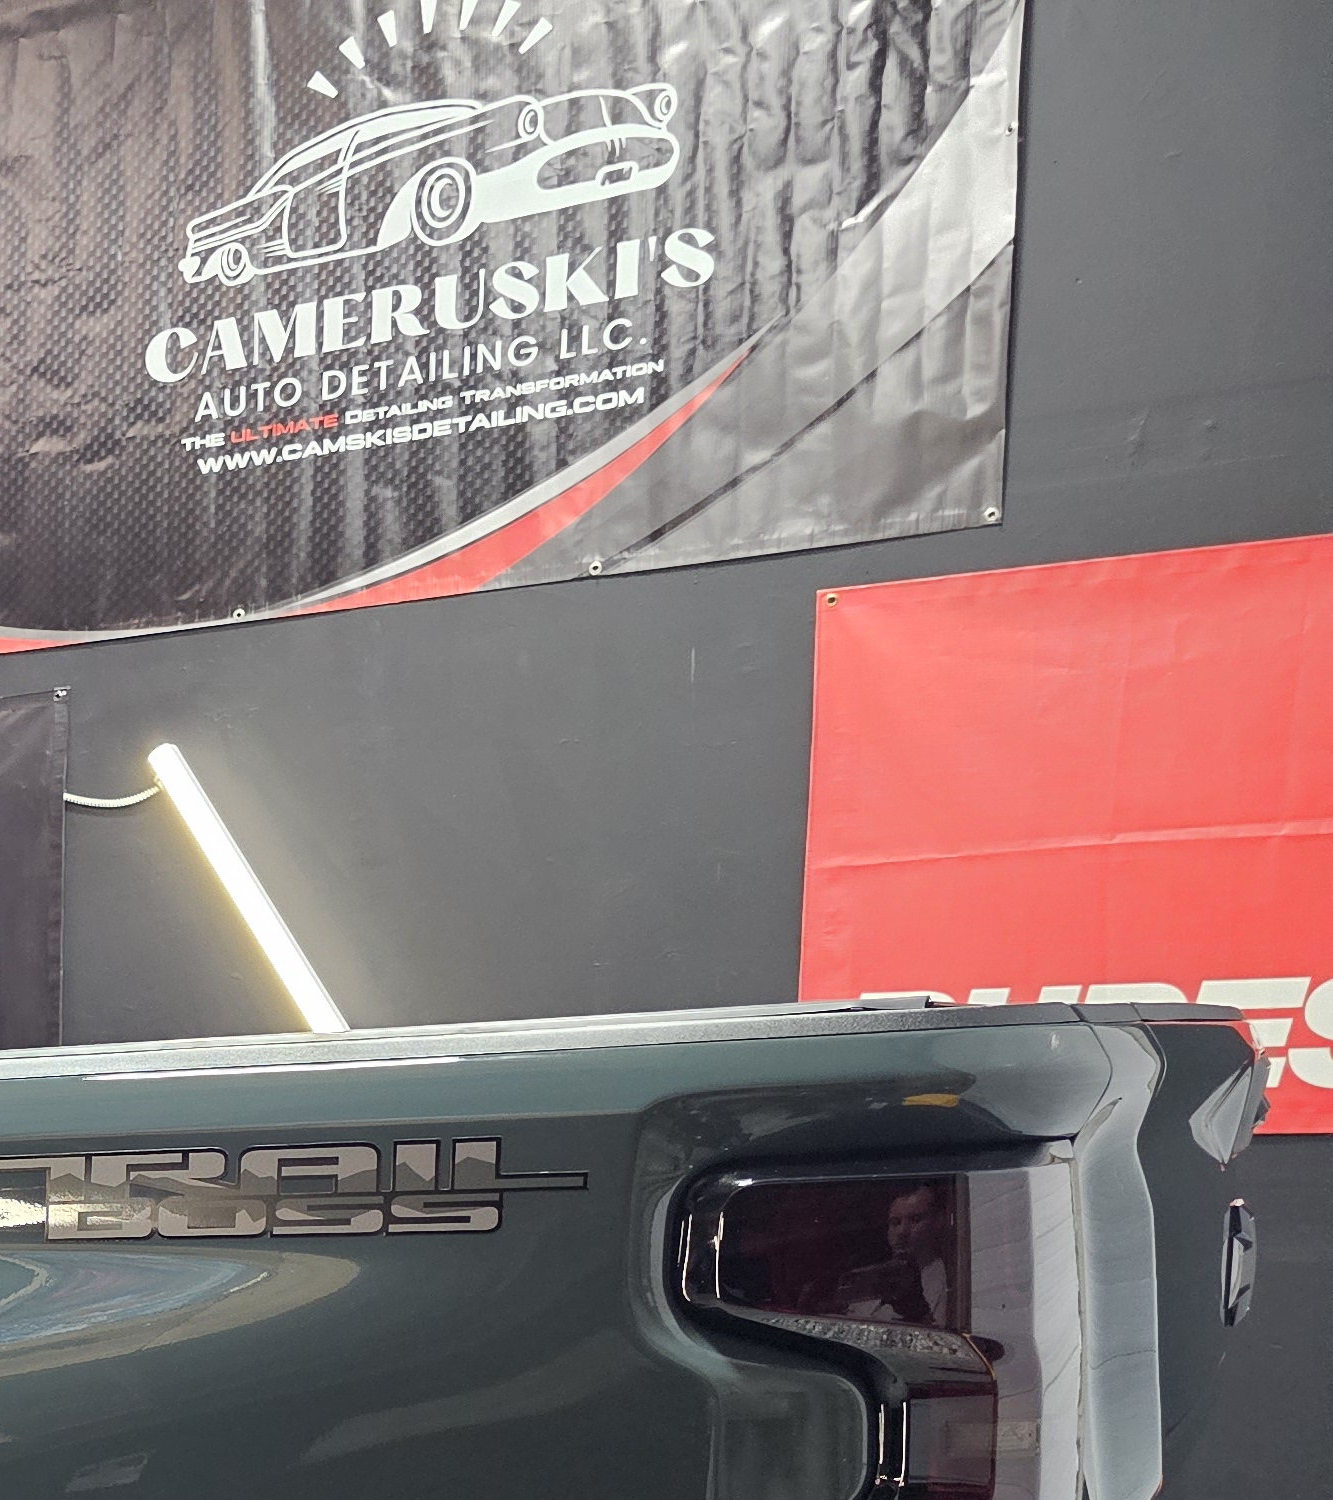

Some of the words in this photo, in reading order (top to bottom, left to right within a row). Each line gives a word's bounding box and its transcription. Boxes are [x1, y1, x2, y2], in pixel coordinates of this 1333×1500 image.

[144, 226, 716, 384] CAMERUSKI'S
[180, 430, 225, 452] THE
[230, 413, 339, 445] ULTIMATE
[344, 394, 454, 425] DETAILING
[460, 359, 665, 406] TRANSFORMATION
[194, 377, 303, 423] AUTO
[321, 335, 539, 400] DETAILING
[559, 317, 649, 361] LLC.
[197, 386, 645, 475] WWW.CAMSKISDETAILING.COM
[46, 1193, 502, 1240] BOSS
